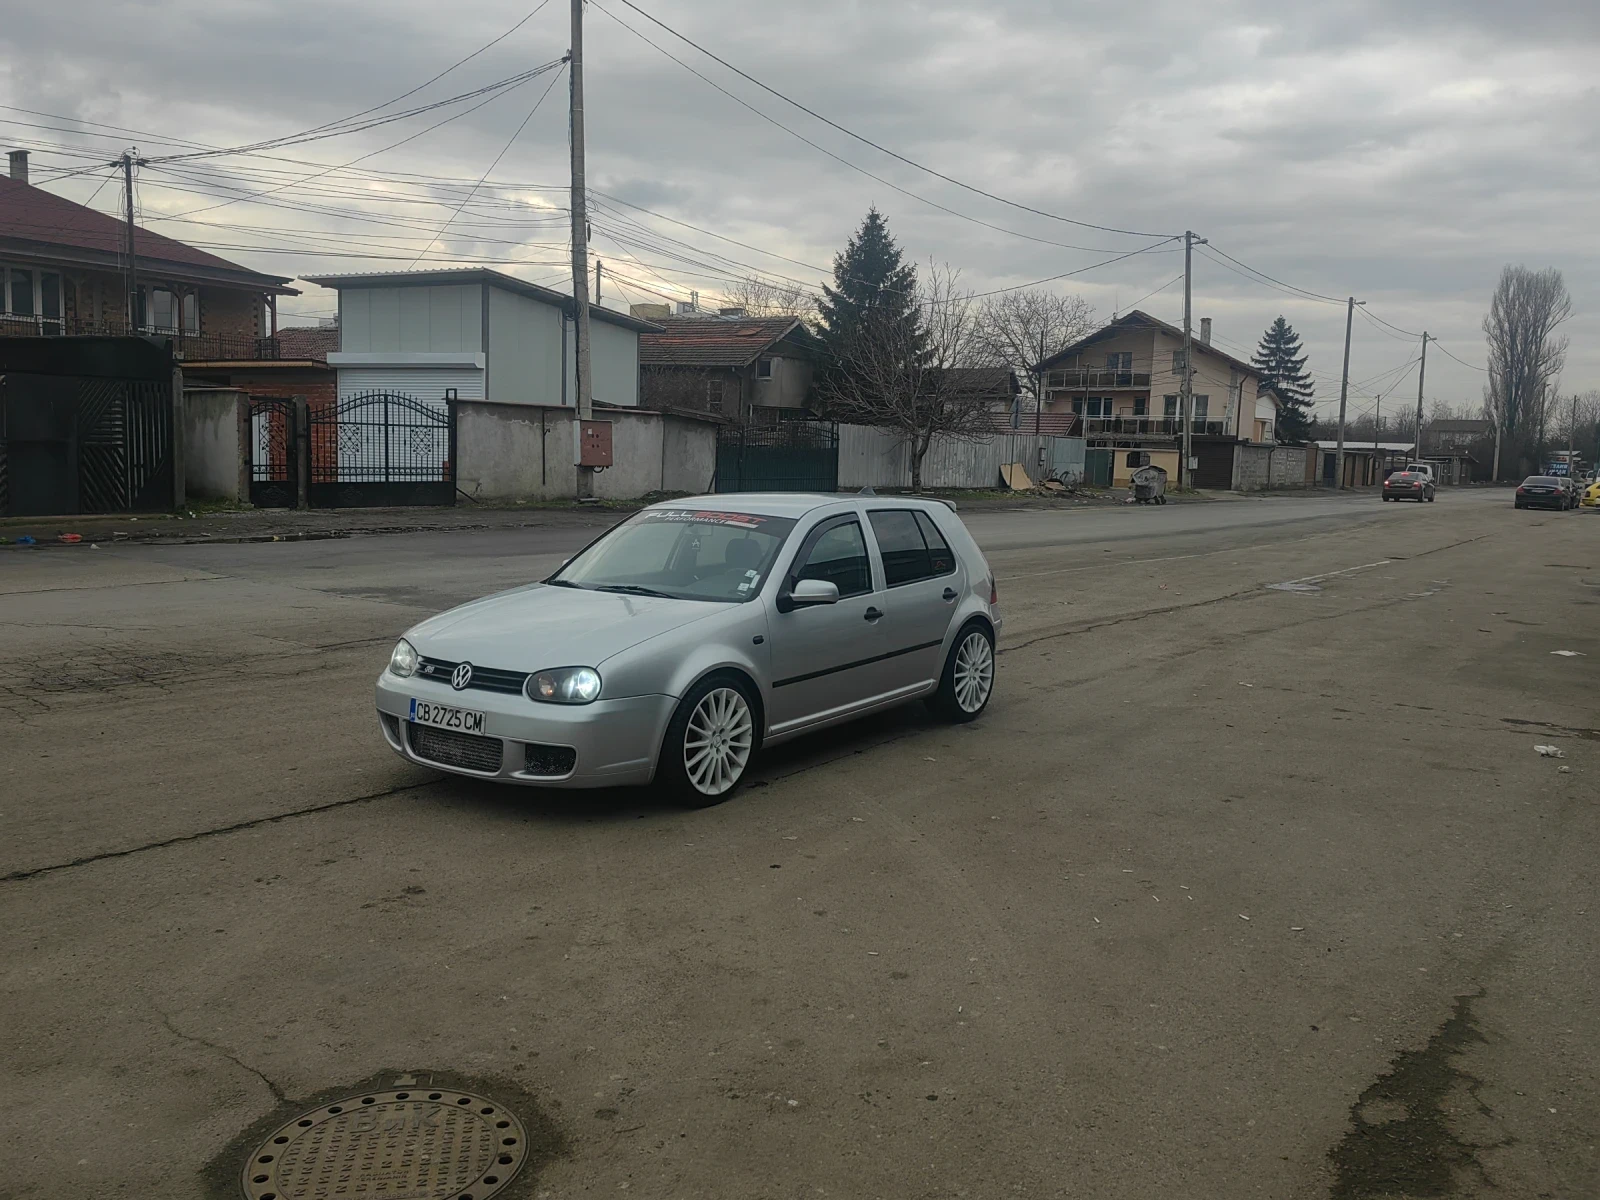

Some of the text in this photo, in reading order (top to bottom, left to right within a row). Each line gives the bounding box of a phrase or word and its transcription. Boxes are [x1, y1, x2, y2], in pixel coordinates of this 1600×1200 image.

[665, 516, 726, 524] PERFORMANCE
[416, 703, 483, 732] CB 2725 CM
